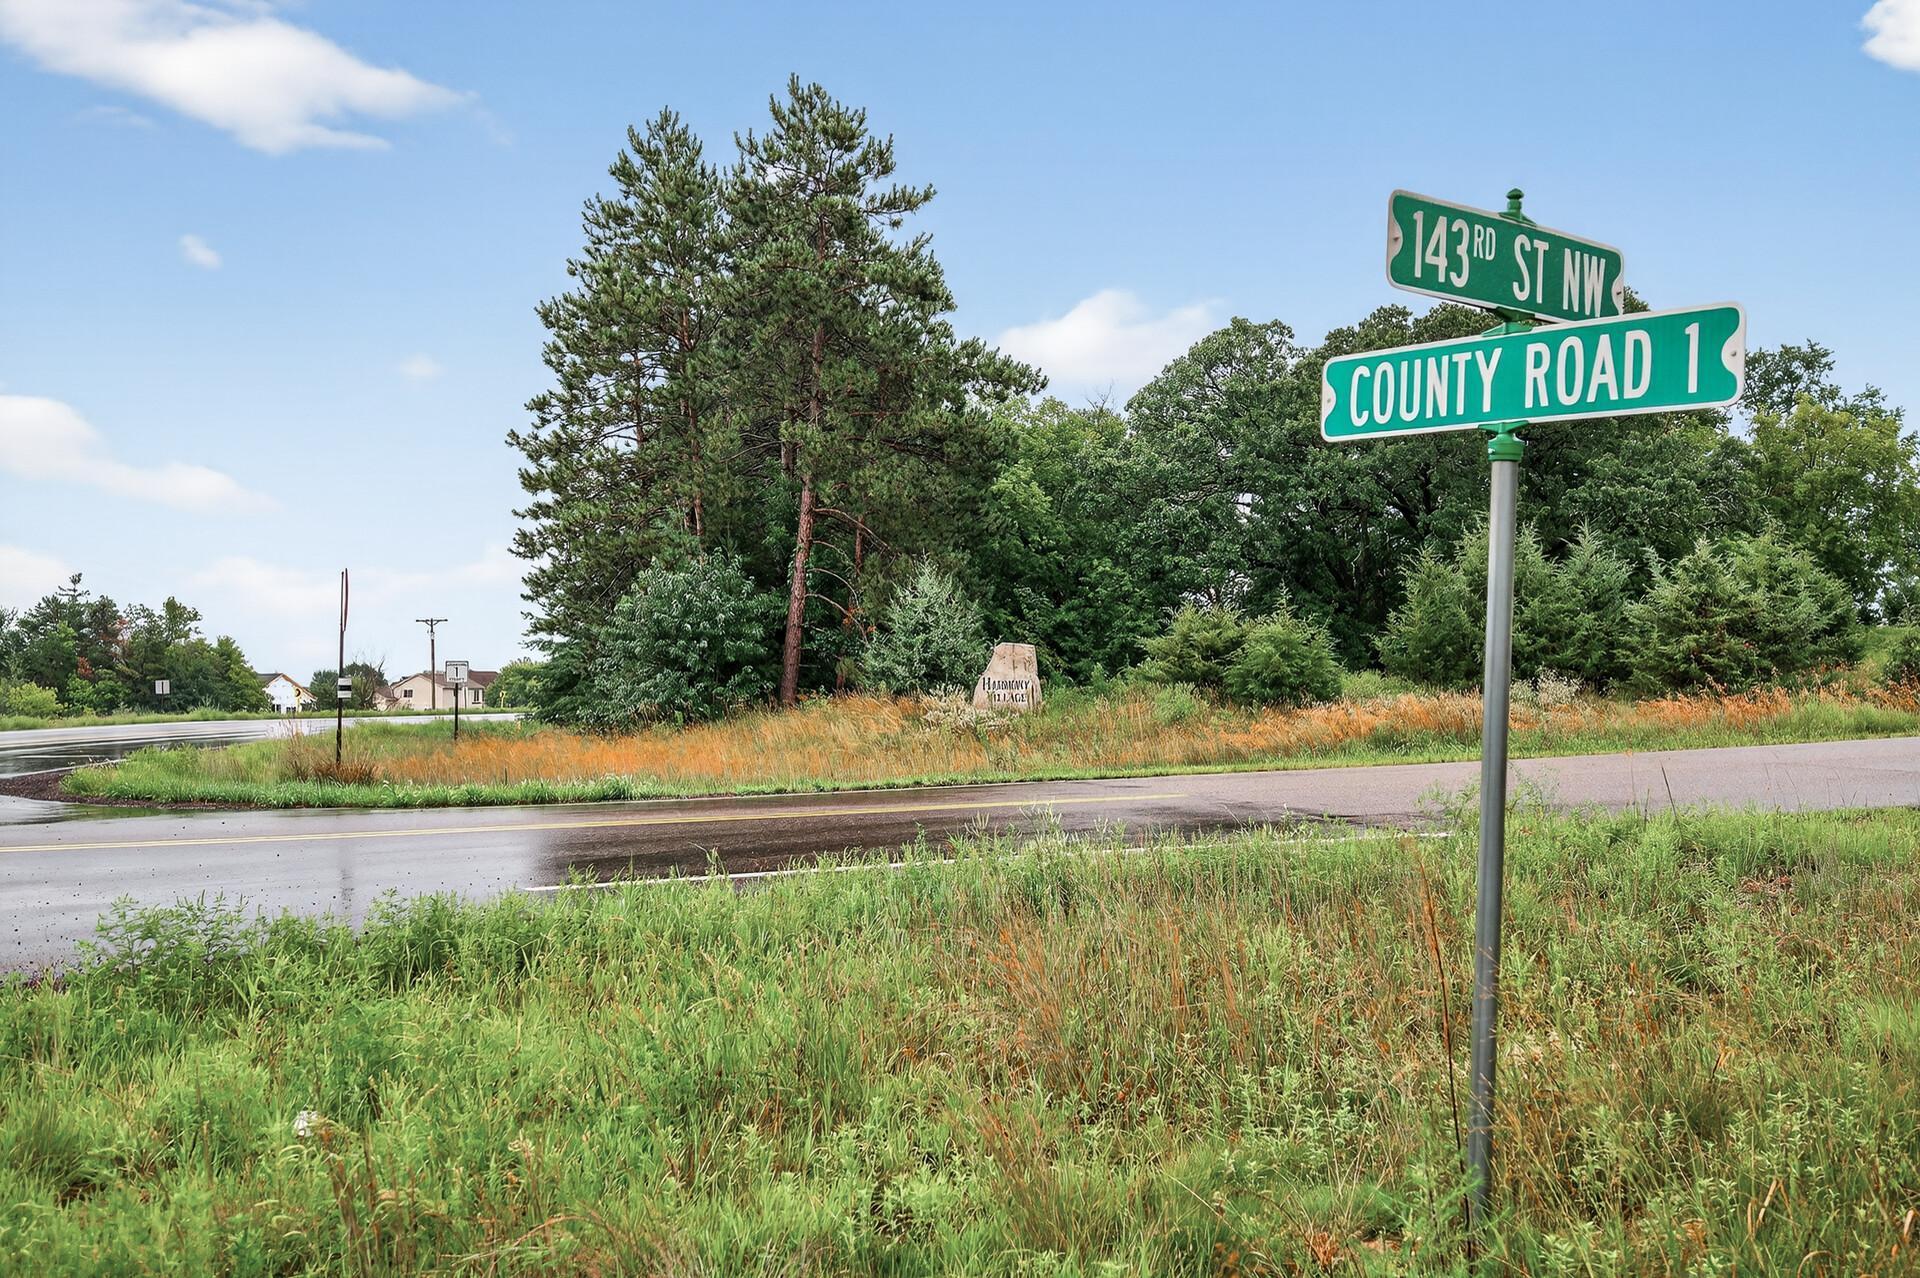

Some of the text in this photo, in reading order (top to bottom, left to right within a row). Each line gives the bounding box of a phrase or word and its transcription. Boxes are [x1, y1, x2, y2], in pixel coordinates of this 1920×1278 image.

[1413, 210, 1606, 318] 143RD ST NW
[1350, 322, 1699, 427] COUNTY ROAD 1
